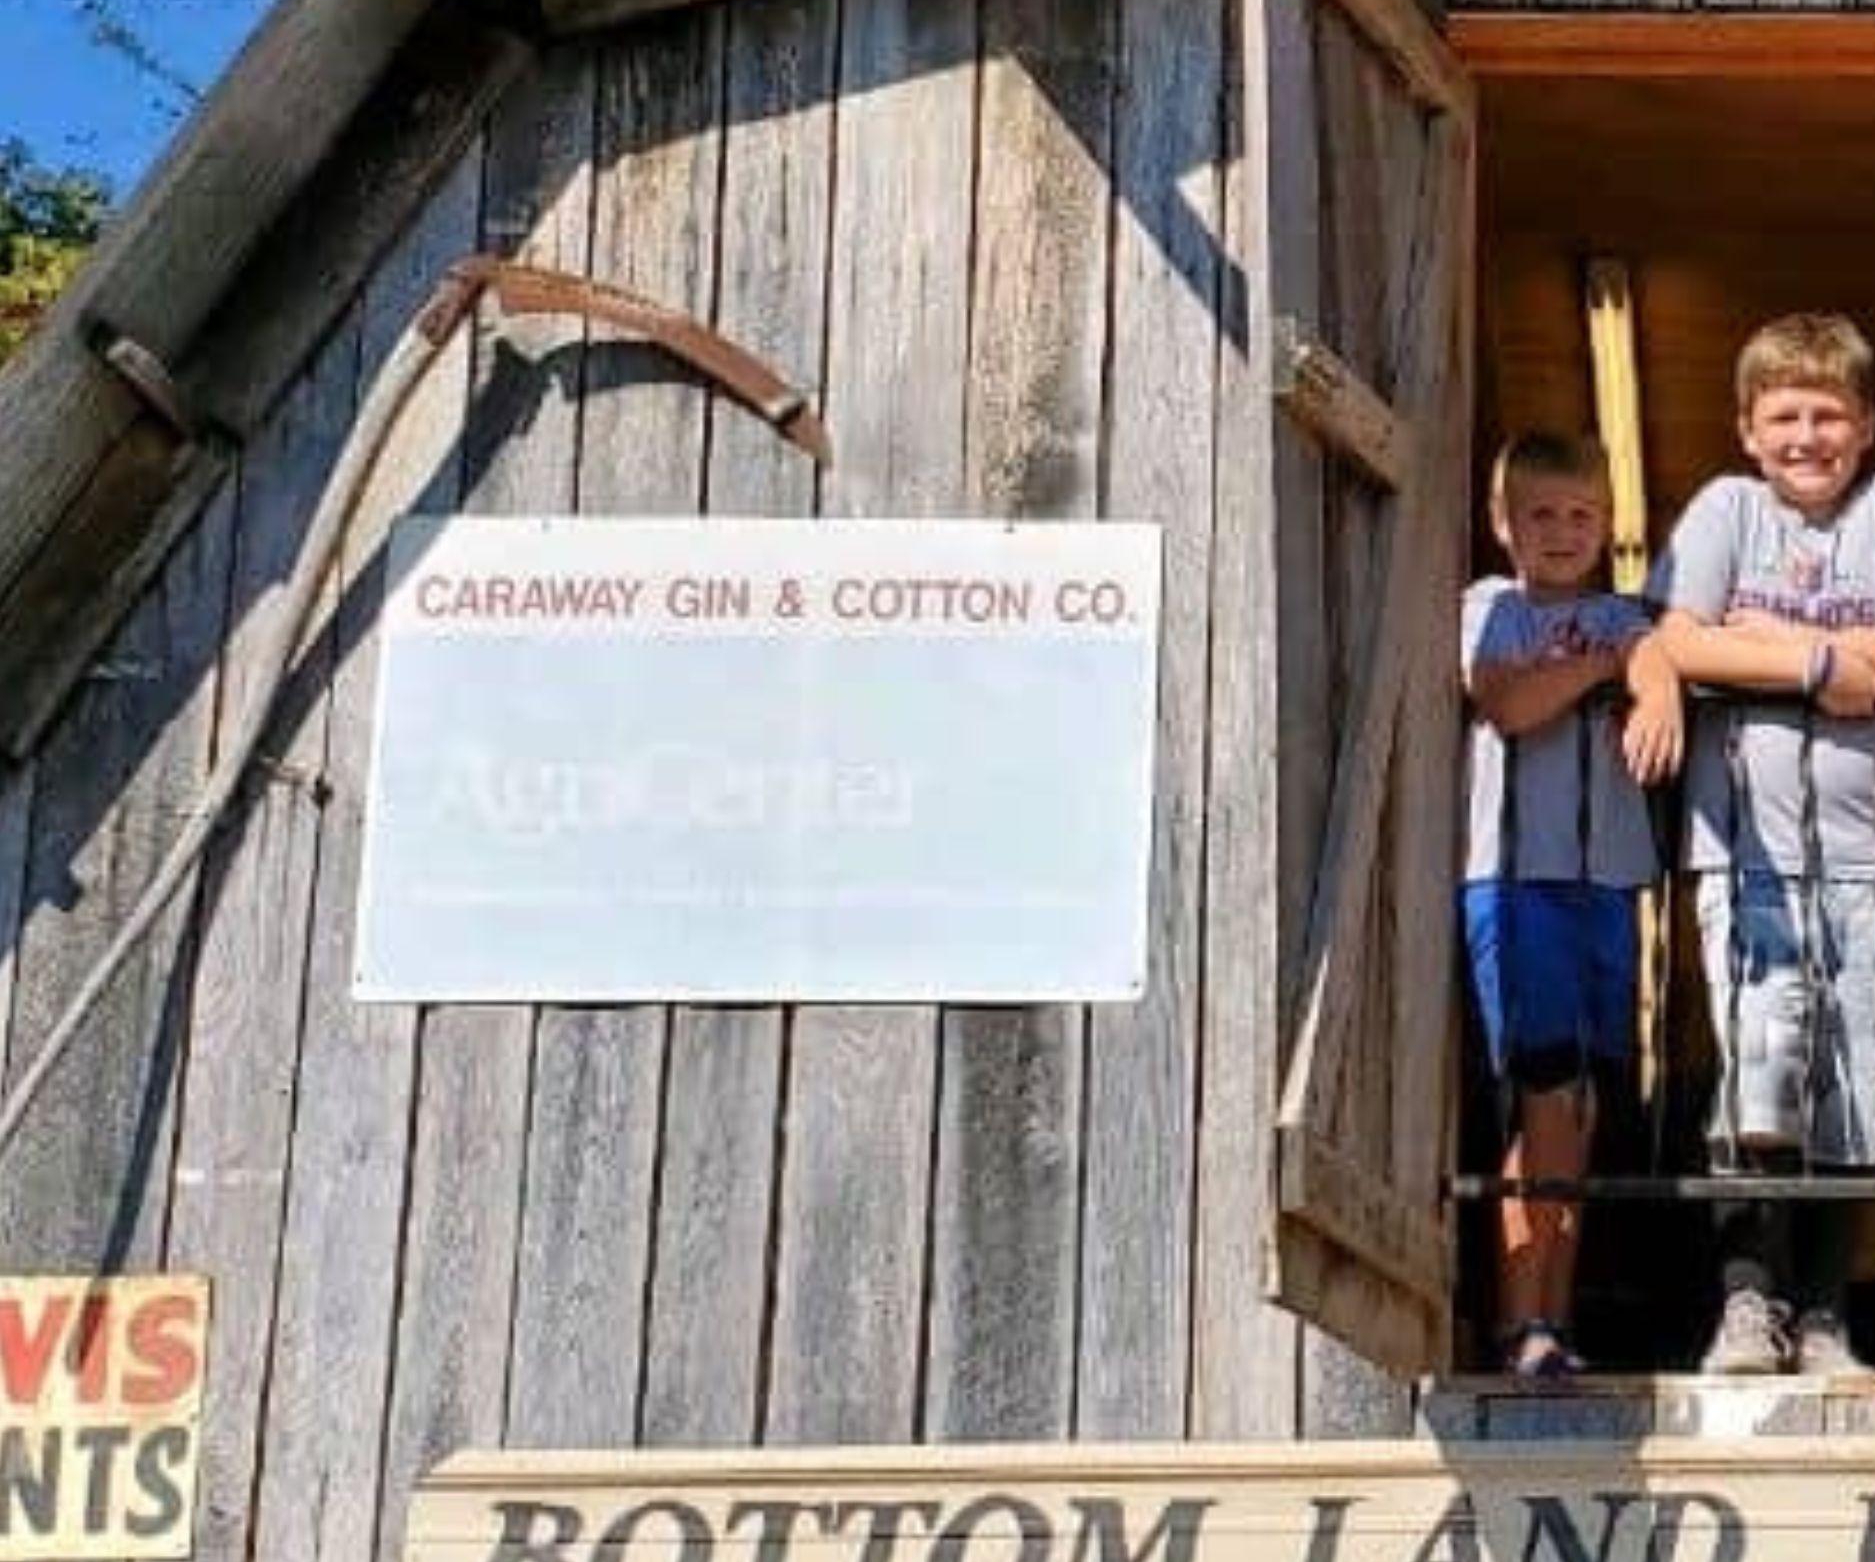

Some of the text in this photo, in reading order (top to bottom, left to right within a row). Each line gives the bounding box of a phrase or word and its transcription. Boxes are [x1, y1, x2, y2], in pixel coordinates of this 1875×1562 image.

[416, 575, 1137, 624] CARAWAY GIN & COTTON CO.
